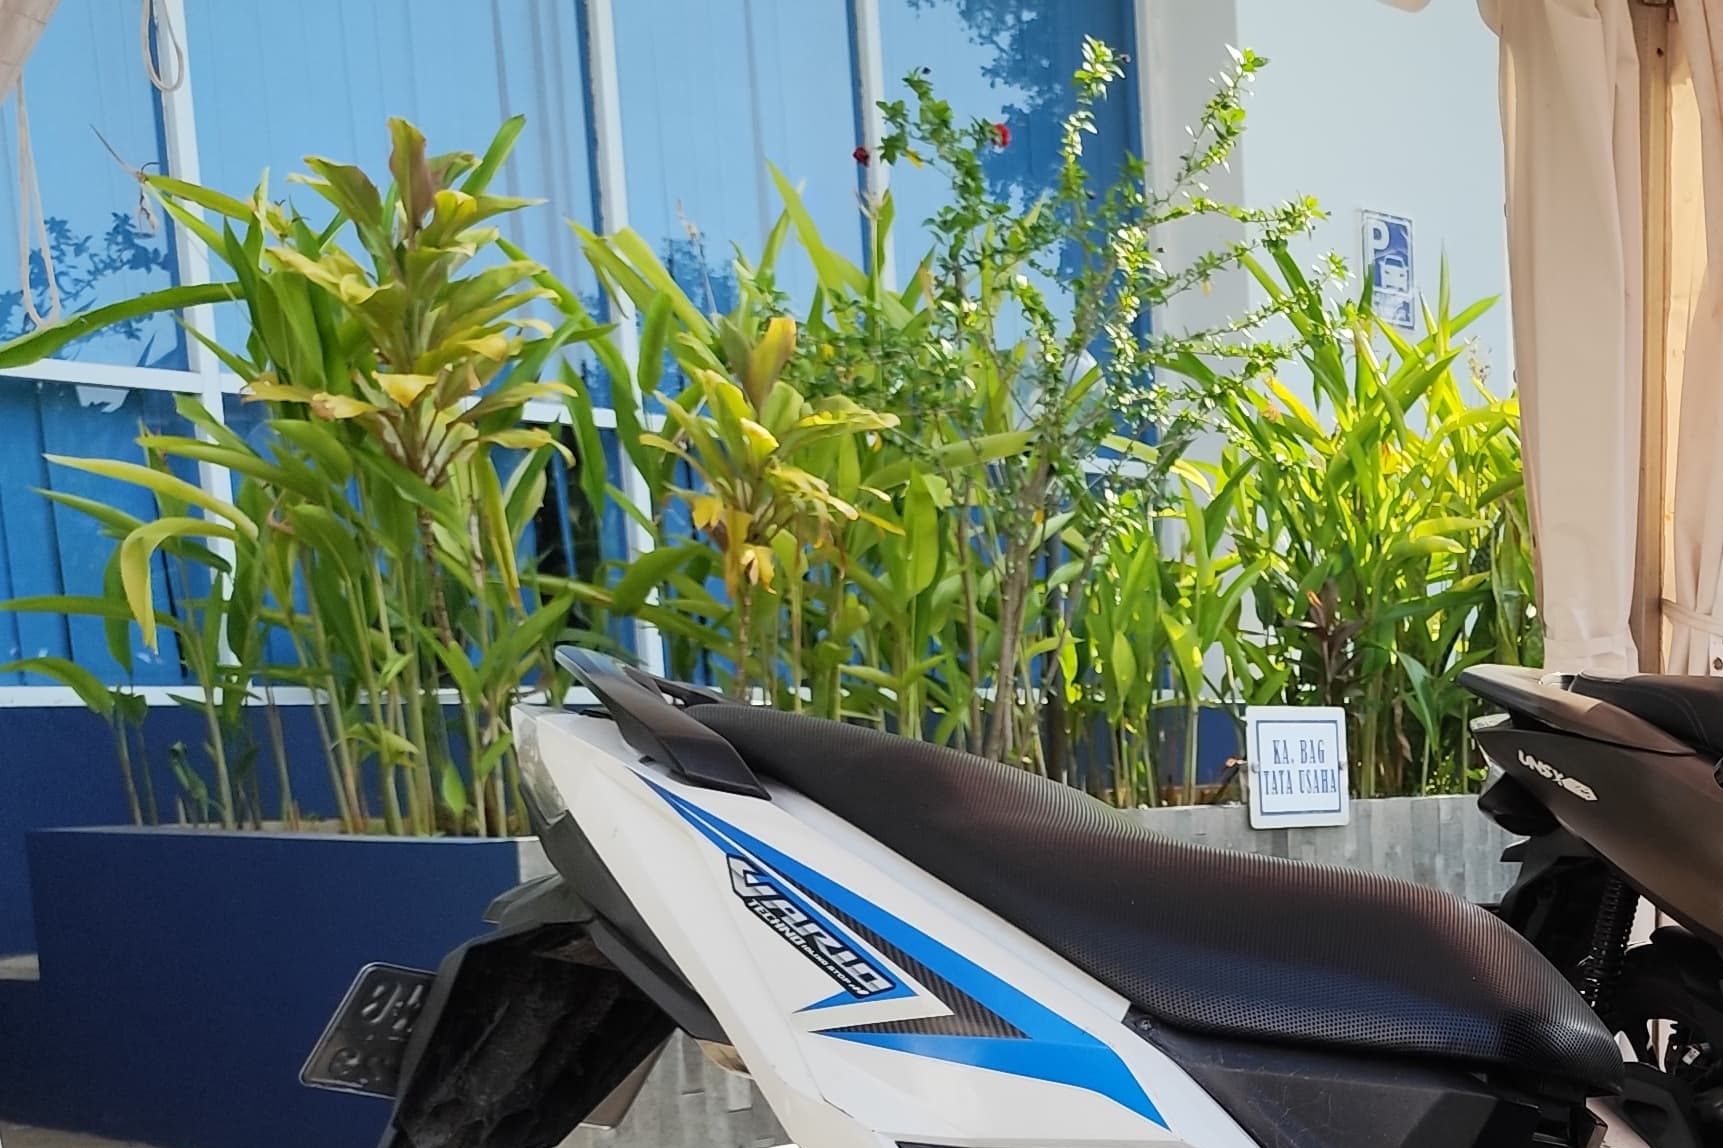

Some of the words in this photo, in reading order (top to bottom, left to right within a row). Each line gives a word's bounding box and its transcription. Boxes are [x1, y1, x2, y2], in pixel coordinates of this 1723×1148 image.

[1366, 217, 1390, 272] P
[1272, 739, 1295, 765] KA.
[1300, 739, 1326, 764] BAG
[1264, 770, 1294, 796] TATA
[1298, 769, 1338, 794] USAHA
[727, 854, 895, 995] VARIO
[746, 898, 808, 946] TECHNO
